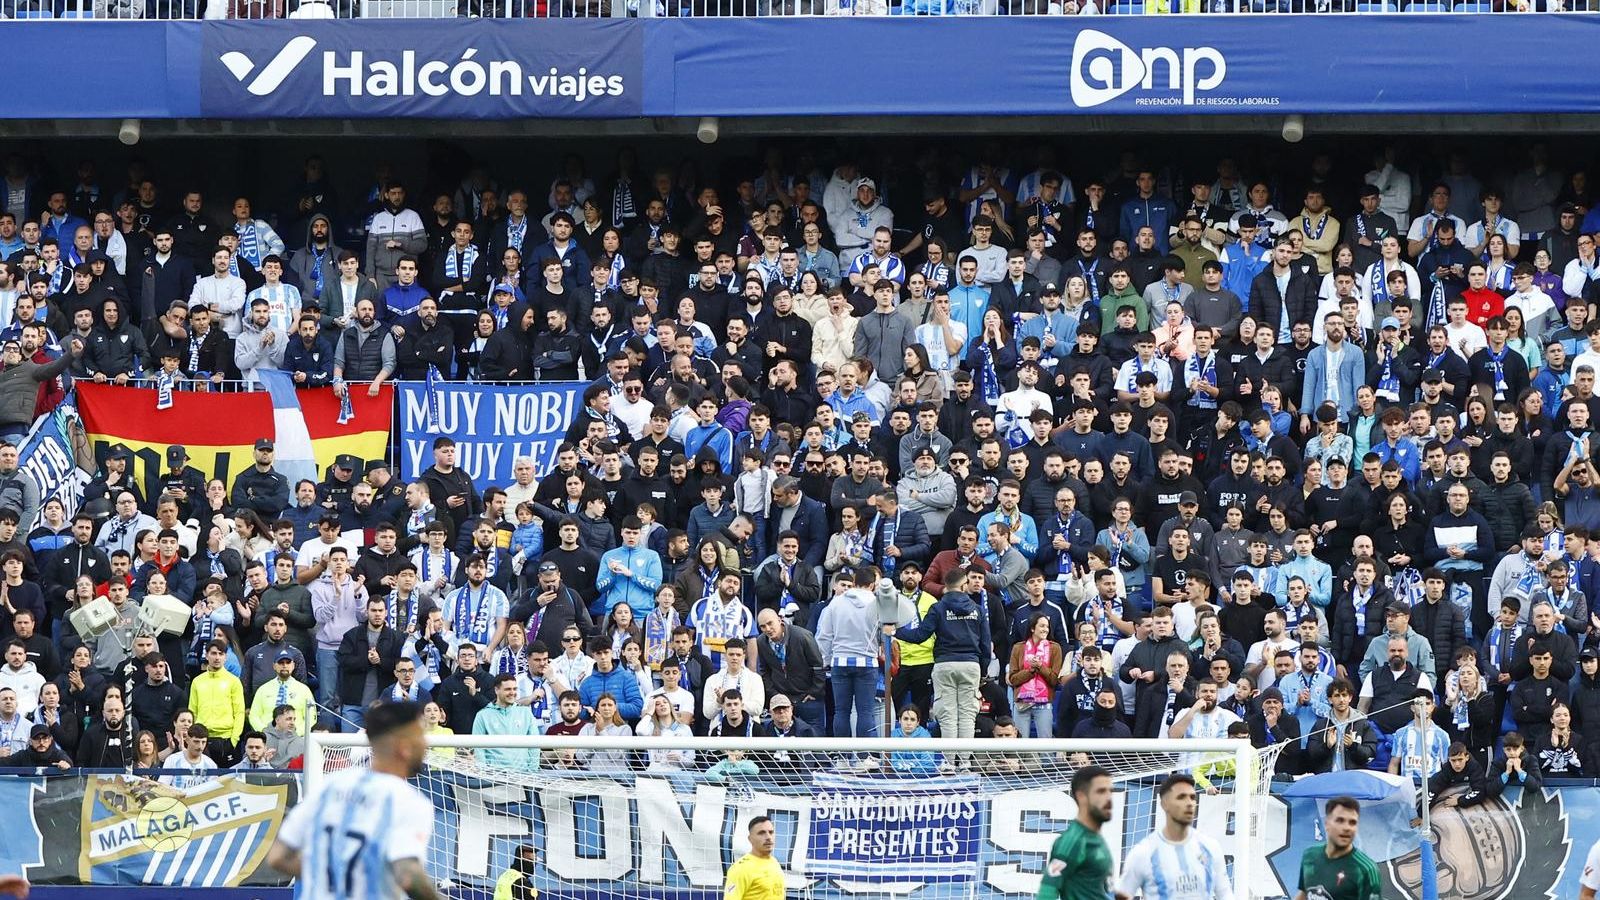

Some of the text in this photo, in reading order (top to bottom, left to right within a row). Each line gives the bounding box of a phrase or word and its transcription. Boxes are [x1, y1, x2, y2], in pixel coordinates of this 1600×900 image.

[322, 47, 624, 103] Halcón viajes
[1080, 46, 1227, 106] anp
[1135, 97, 1182, 106] PREVENCIÓN
[404, 388, 483, 436] MUY
[98, 795, 248, 852] MALAGA C.F.
[816, 791, 977, 823] SANCIONADOS
[324, 825, 366, 897] 17
[828, 826, 960, 857] PRESENTES
